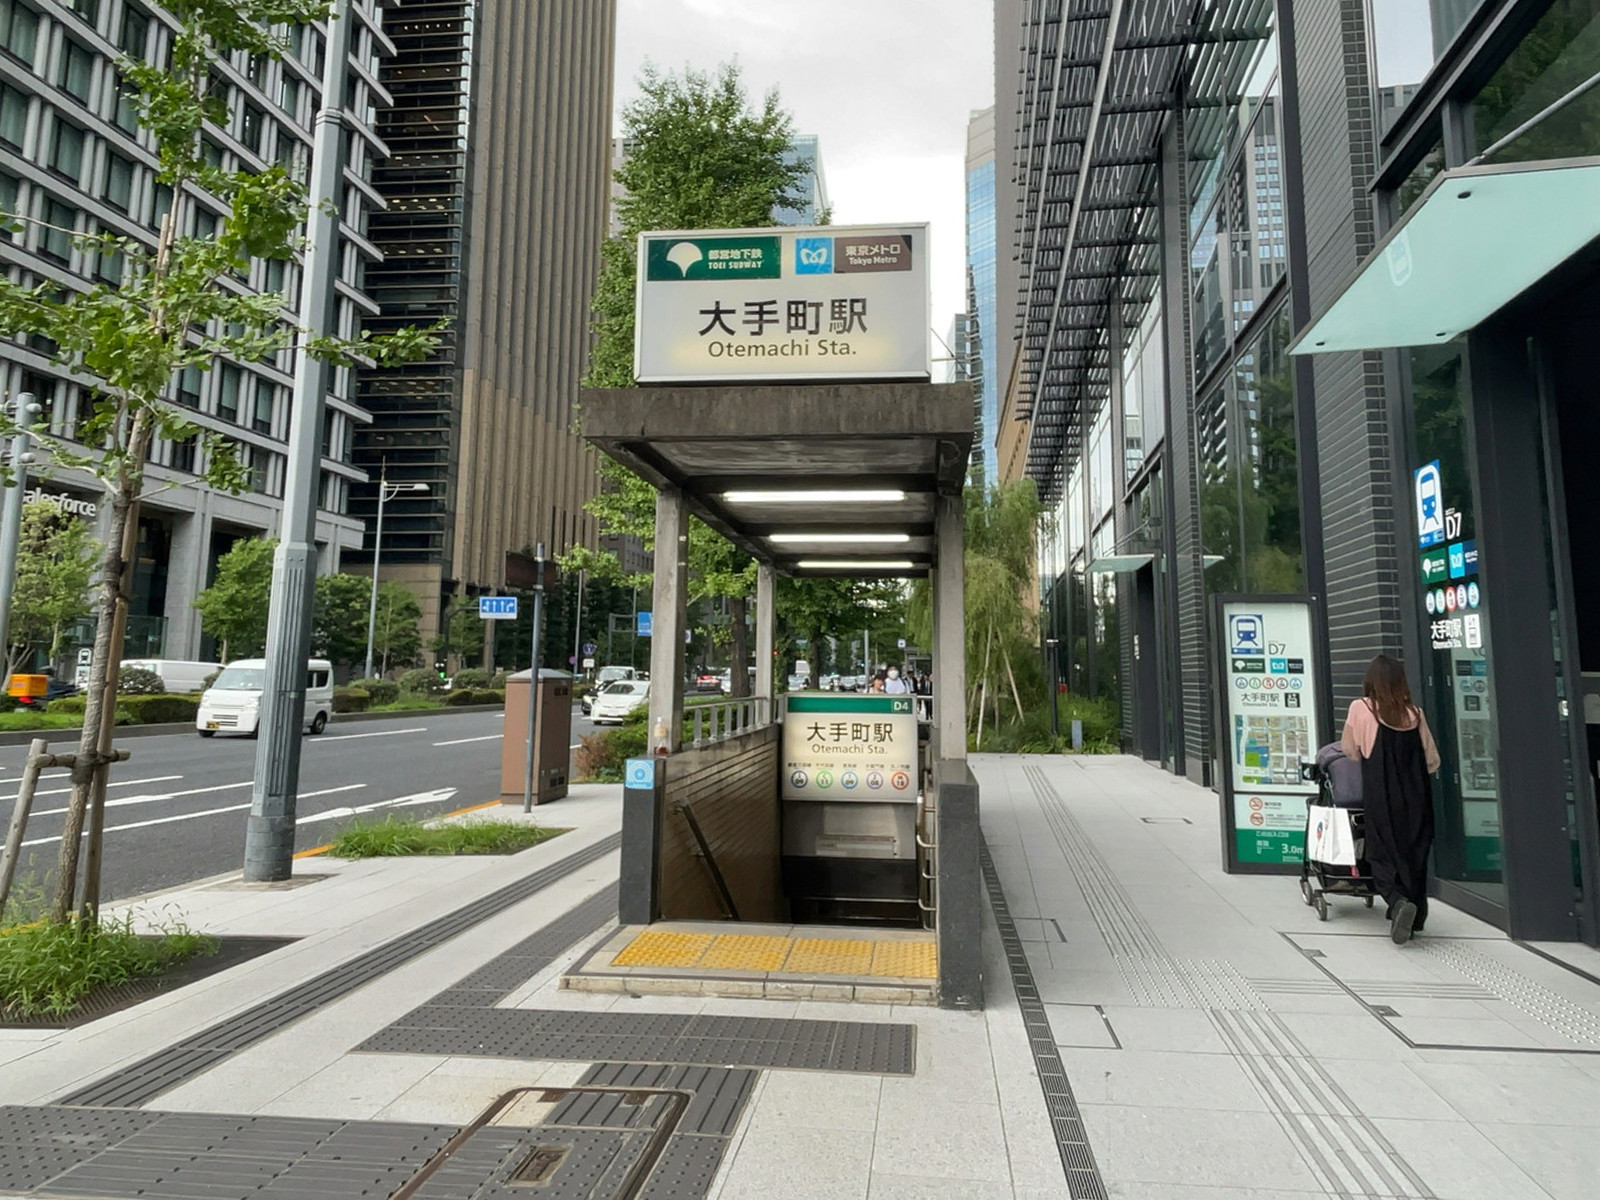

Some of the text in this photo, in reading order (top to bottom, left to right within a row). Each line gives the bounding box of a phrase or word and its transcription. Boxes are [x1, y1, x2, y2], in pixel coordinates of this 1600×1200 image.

[708, 249, 763, 260] 都営地下鉄
[845, 244, 901, 256] 東京メトロ
[708, 261, 762, 270] TOEI SUBWAY
[849, 256, 897, 266] Tokyo Metro
[699, 298, 868, 336] 大手町駅
[708, 339, 857, 358] Otemachi Sta.
[1445, 512, 1462, 540] D7
[1269, 643, 1286, 655] D7
[1241, 693, 1280, 702] 大手町駅
[894, 701, 909, 711] D4
[807, 722, 893, 742] 大手町駅
[812, 743, 888, 755] Otemachi Sta.
